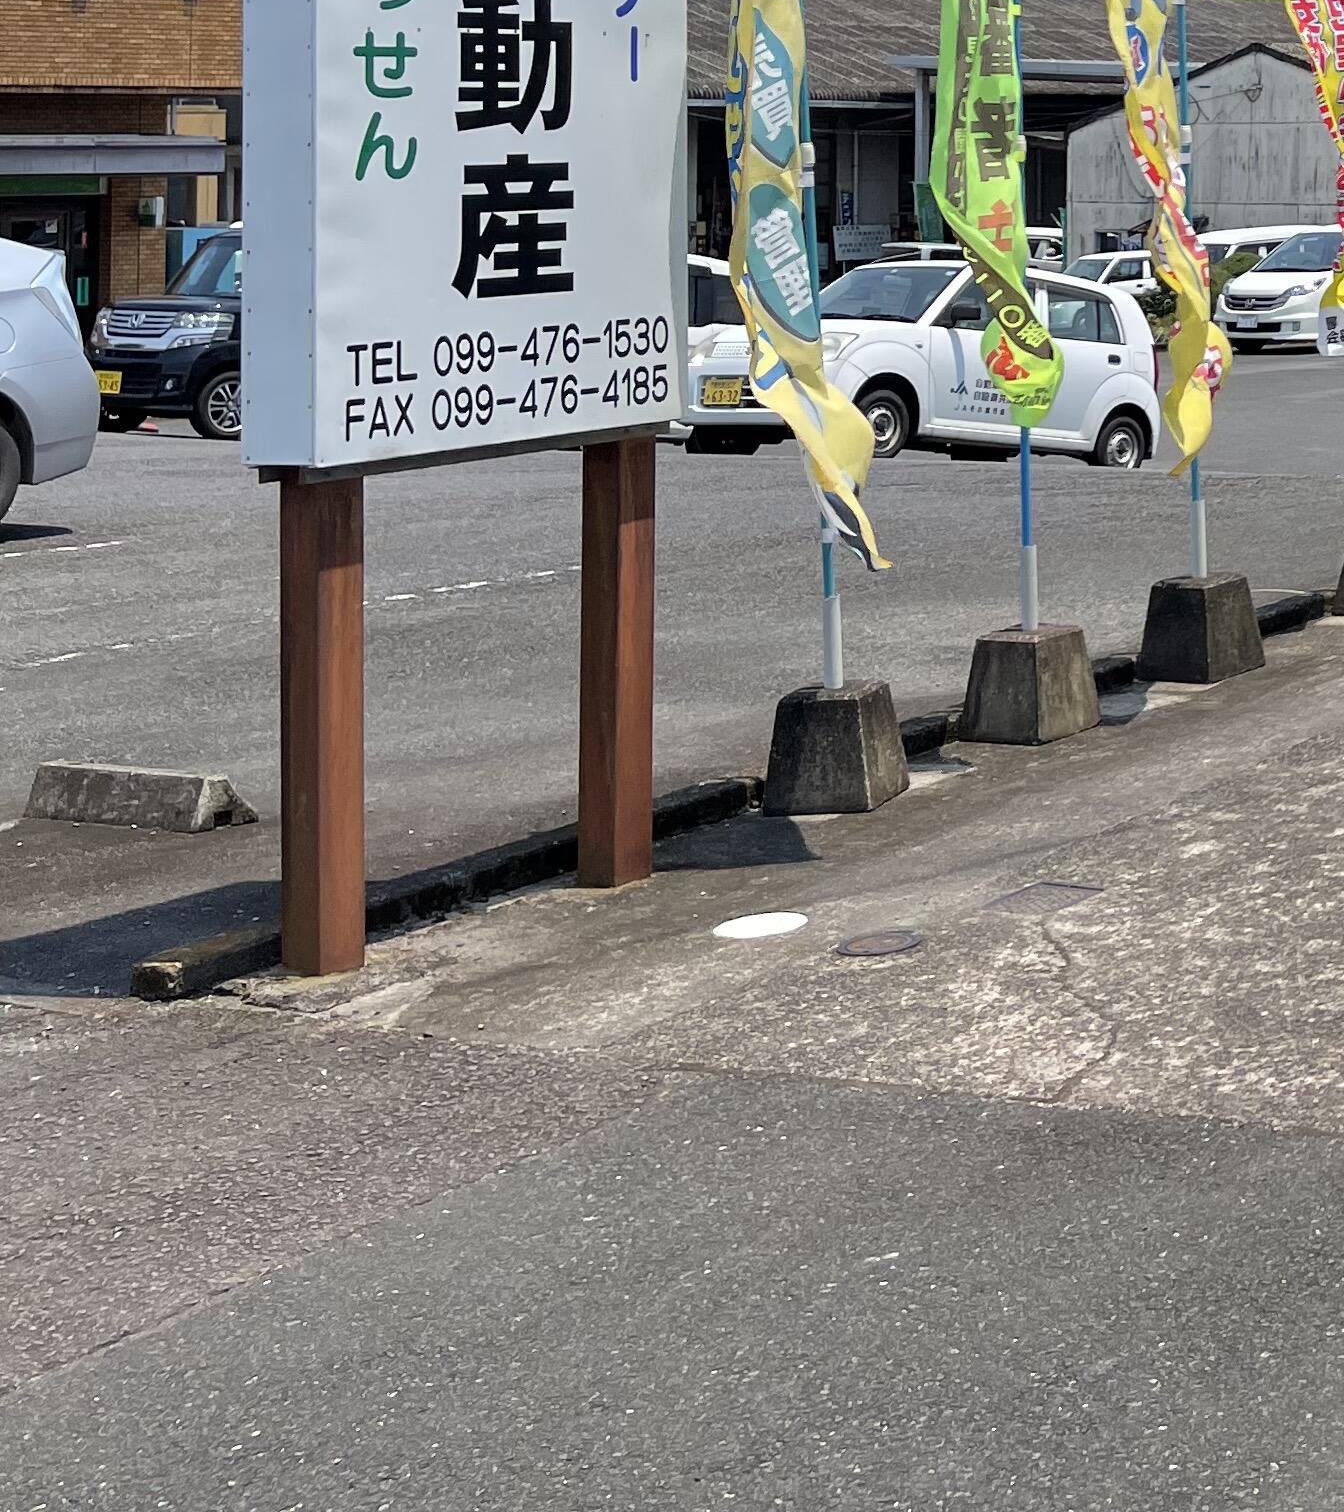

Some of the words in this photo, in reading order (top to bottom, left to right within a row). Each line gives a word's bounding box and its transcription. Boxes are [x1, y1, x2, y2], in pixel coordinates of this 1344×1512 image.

[347, 340, 418, 388] TEL
[434, 315, 670, 378] 099-476-1530
[344, 393, 414, 443] FAX
[431, 364, 670, 431] 099-476-4185
